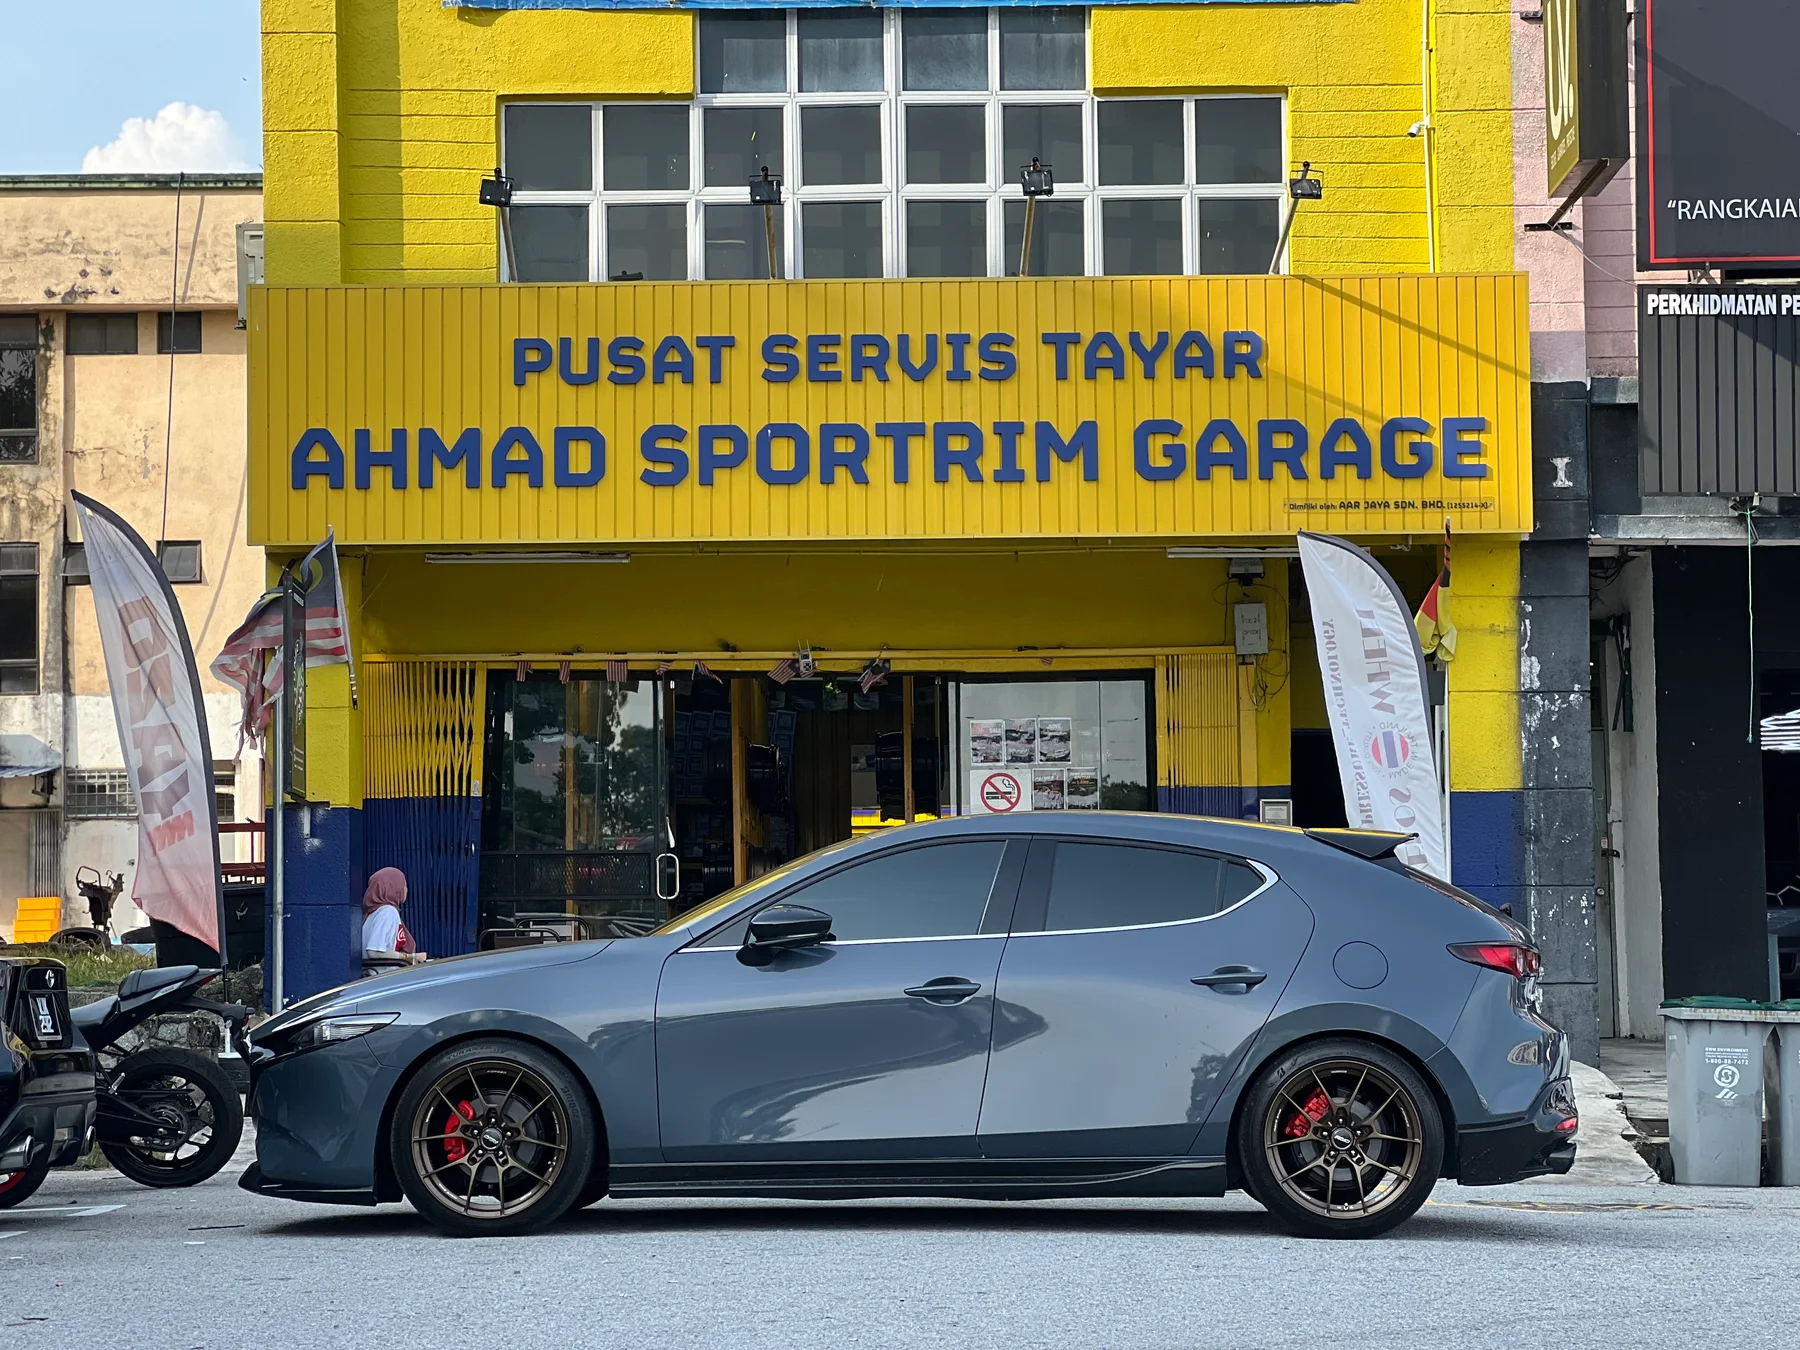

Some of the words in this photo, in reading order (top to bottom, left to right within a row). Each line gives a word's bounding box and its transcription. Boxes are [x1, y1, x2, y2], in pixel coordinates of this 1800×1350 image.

[1667, 197, 1800, 220] “RANGKAIA
[1647, 293, 1777, 316] PERKHIDMATAN
[1781, 294, 1800, 316] PE
[514, 336, 736, 386] PUSAT
[761, 333, 1017, 382] SERVIS
[1042, 330, 1264, 380] TAYAR
[291, 426, 606, 490] AHMAD
[640, 421, 1099, 486] SPORTRIM
[1133, 417, 1489, 482] GARAGE
[1339, 501, 1361, 510] AAR
[1364, 500, 1390, 510] JAYA
[1393, 500, 1418, 509] SDN.
[1421, 500, 1446, 509] BHD.
